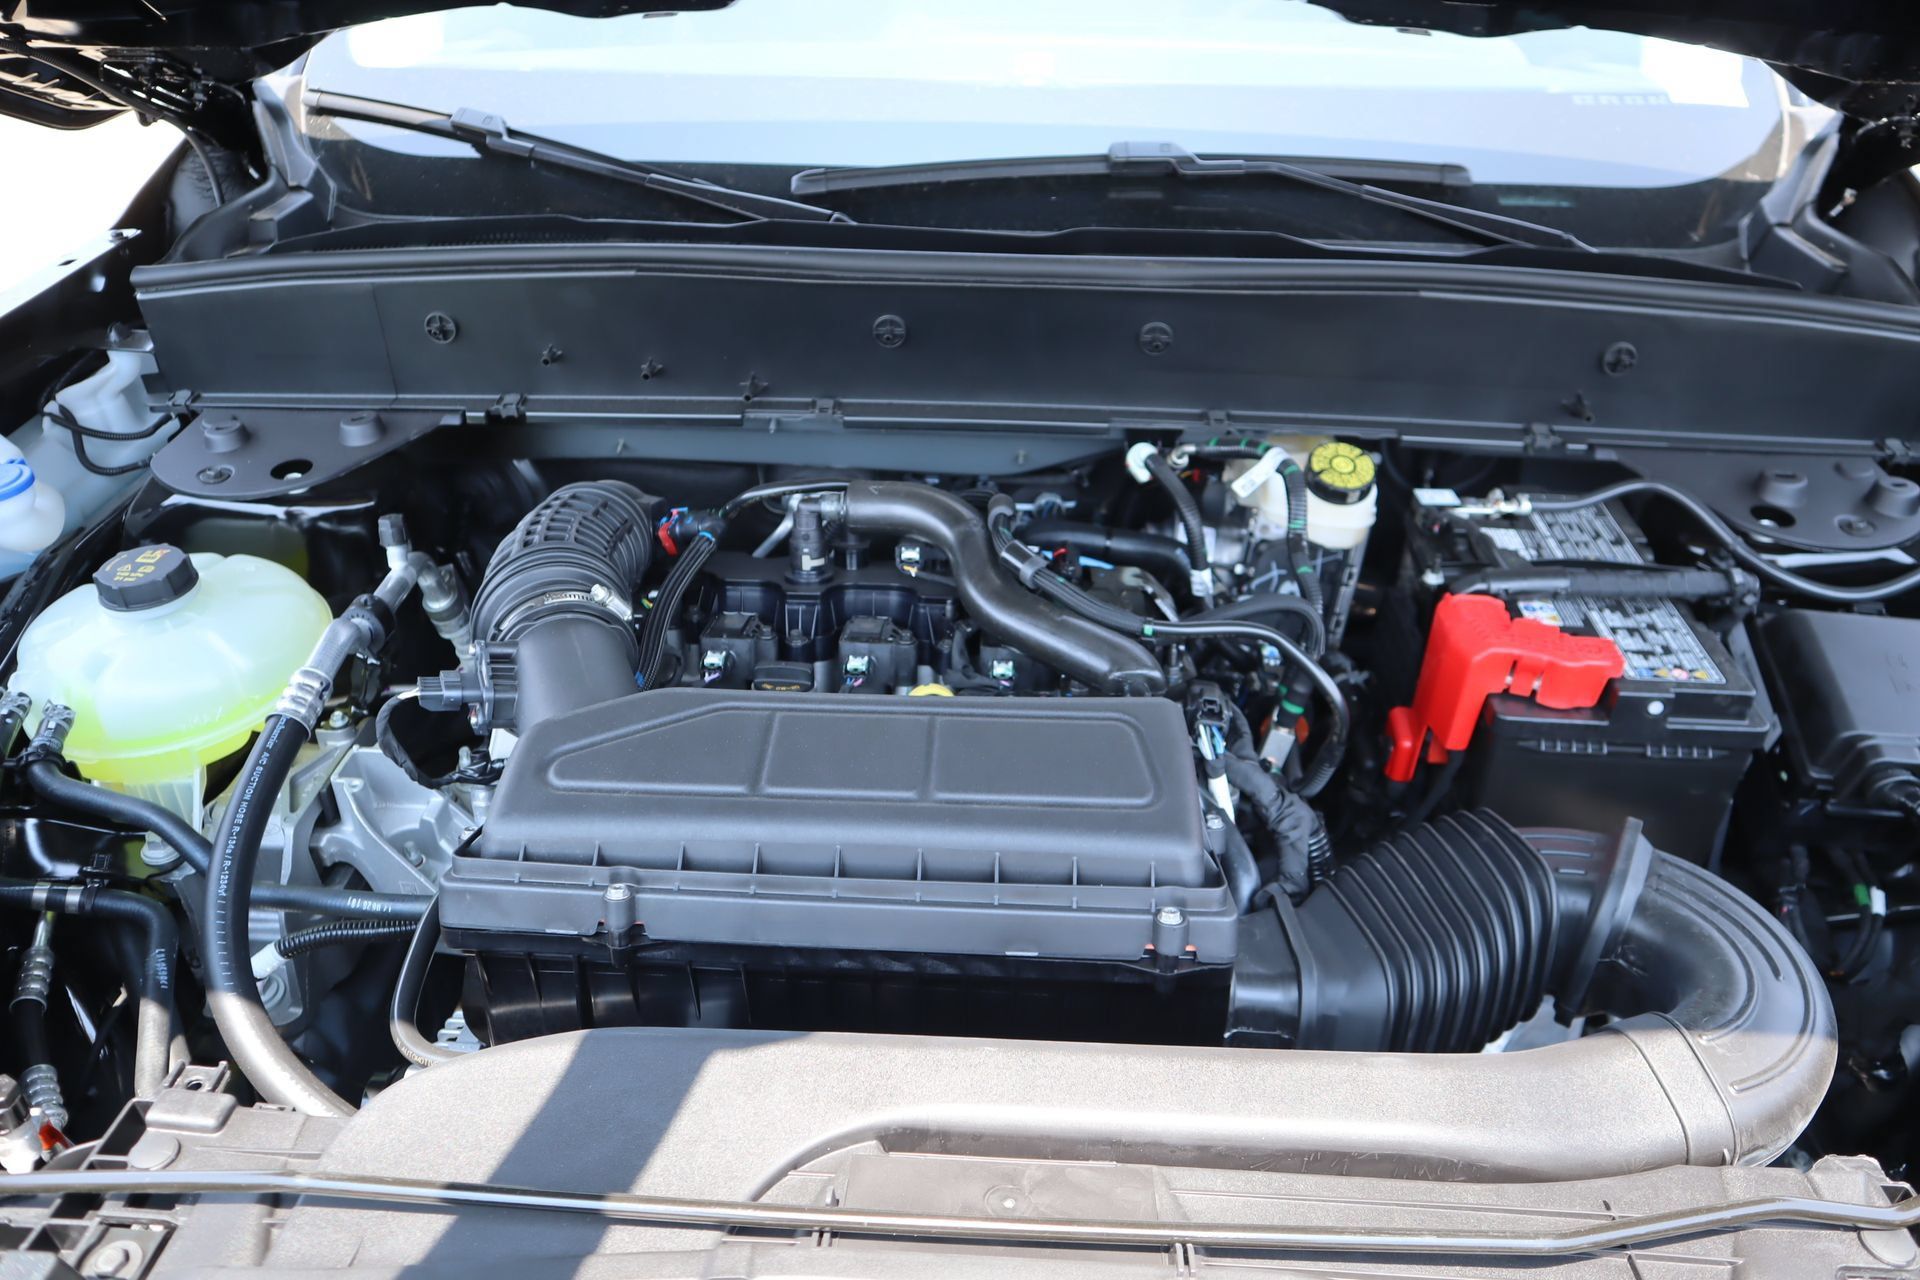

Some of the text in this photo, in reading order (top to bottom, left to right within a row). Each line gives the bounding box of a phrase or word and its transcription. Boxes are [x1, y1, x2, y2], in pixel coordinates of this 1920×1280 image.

[246, 766, 264, 802] SUCTION
[234, 801, 249, 824] HOSE
[225, 826, 241, 854] R-134a
